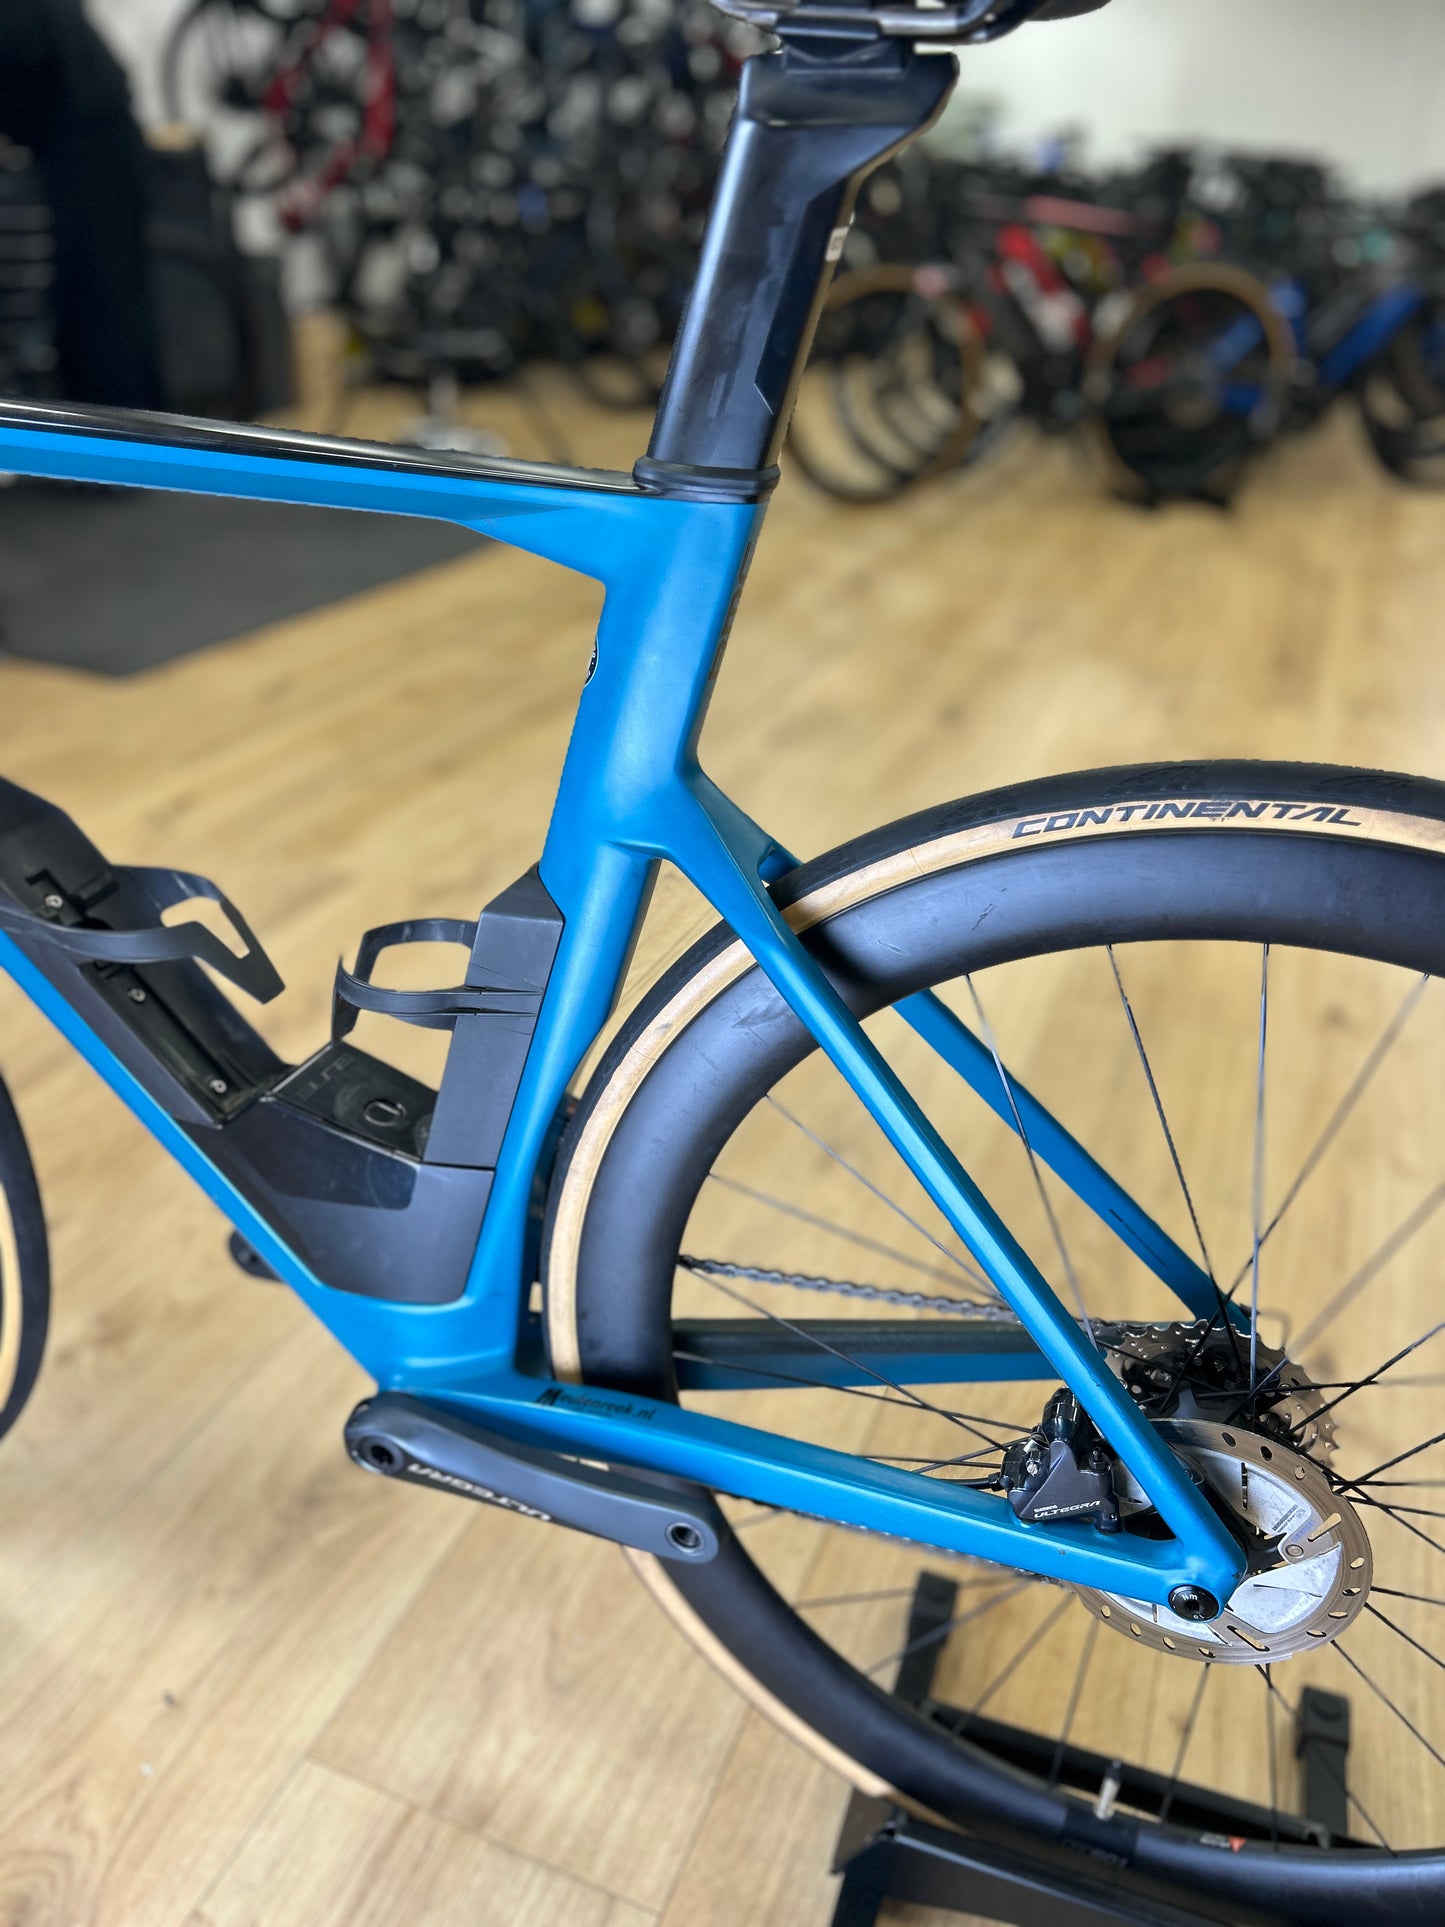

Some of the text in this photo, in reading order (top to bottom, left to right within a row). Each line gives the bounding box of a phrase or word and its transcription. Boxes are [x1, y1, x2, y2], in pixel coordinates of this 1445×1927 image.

[1011, 801, 1361, 839] CONTINENTAL
[406, 1462, 553, 1521] ULTEGRA
[1034, 1500, 1101, 1518] ULTEGRA
